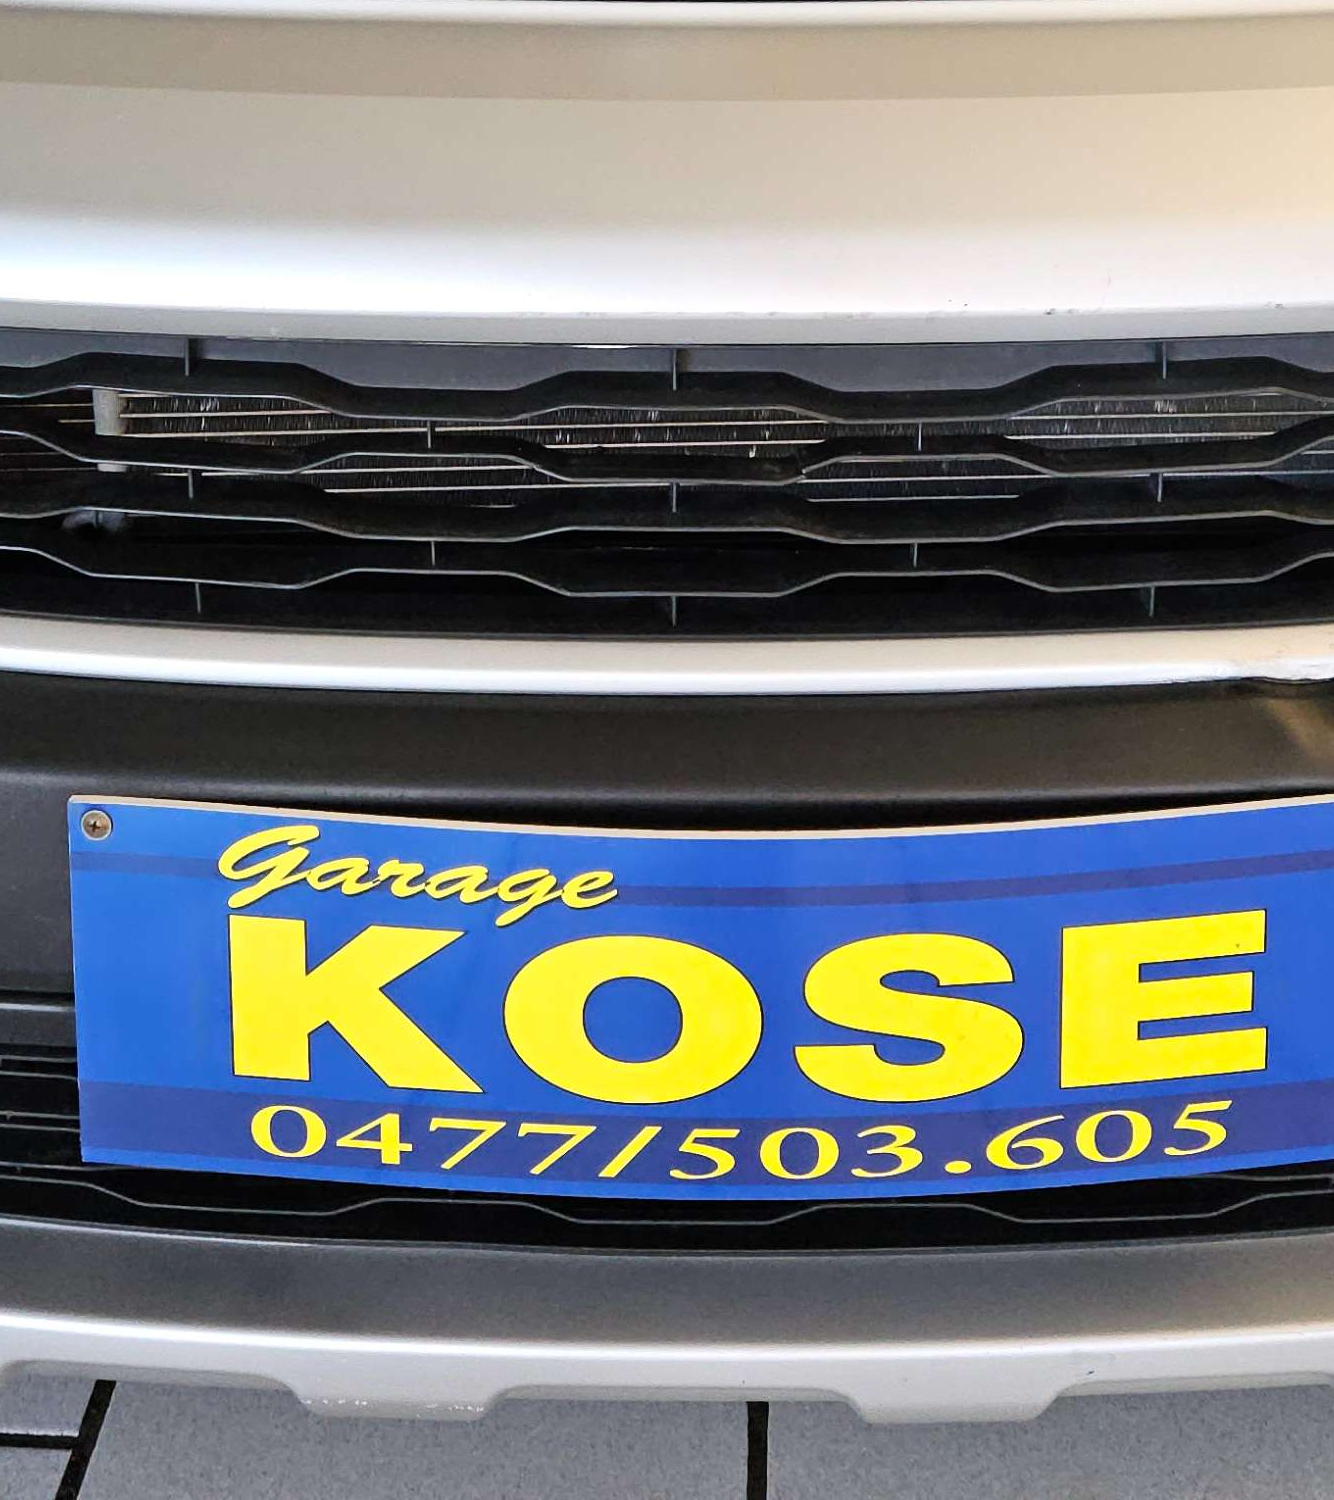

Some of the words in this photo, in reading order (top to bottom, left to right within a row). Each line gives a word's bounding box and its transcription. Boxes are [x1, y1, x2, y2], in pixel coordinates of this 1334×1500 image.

[217, 825, 618, 928] Garage
[228, 908, 1267, 1105] KOSE
[250, 1100, 1230, 1179] 0477/503.605
